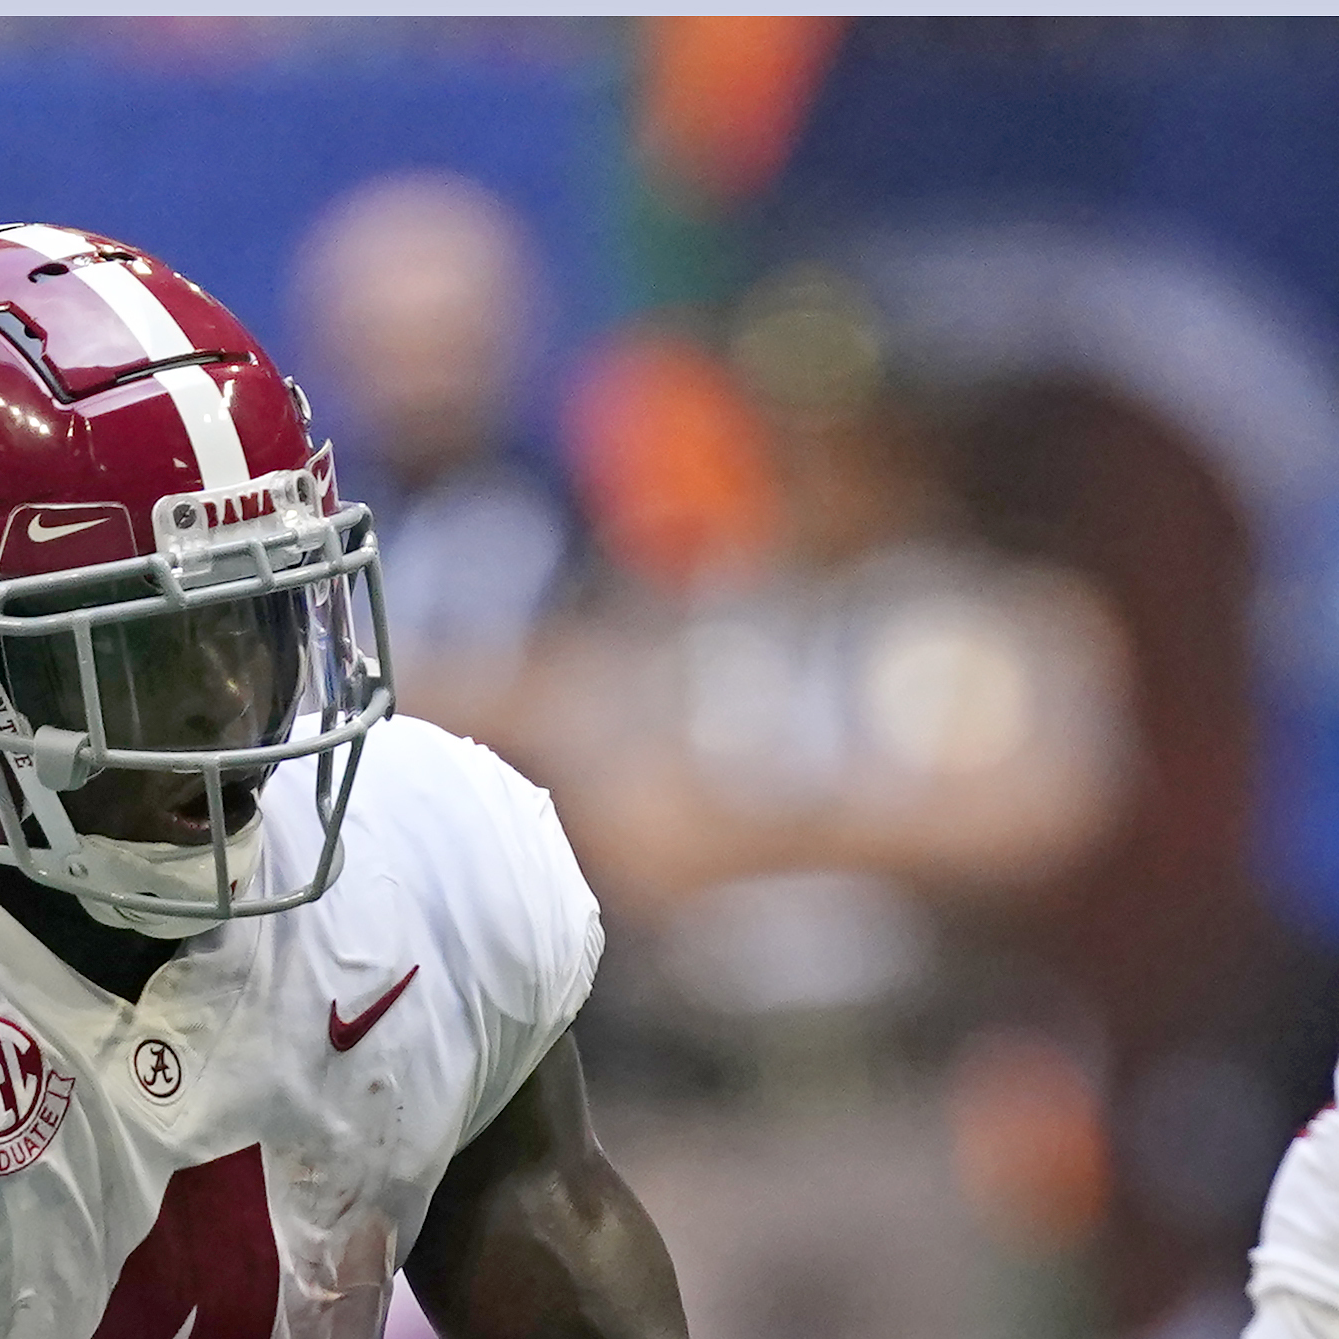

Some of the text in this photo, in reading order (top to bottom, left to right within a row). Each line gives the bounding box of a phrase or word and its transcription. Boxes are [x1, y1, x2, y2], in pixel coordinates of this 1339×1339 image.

[202, 489, 276, 528] BAMA
[0, 718, 33, 769] TE
[144, 1048, 173, 1086] A
